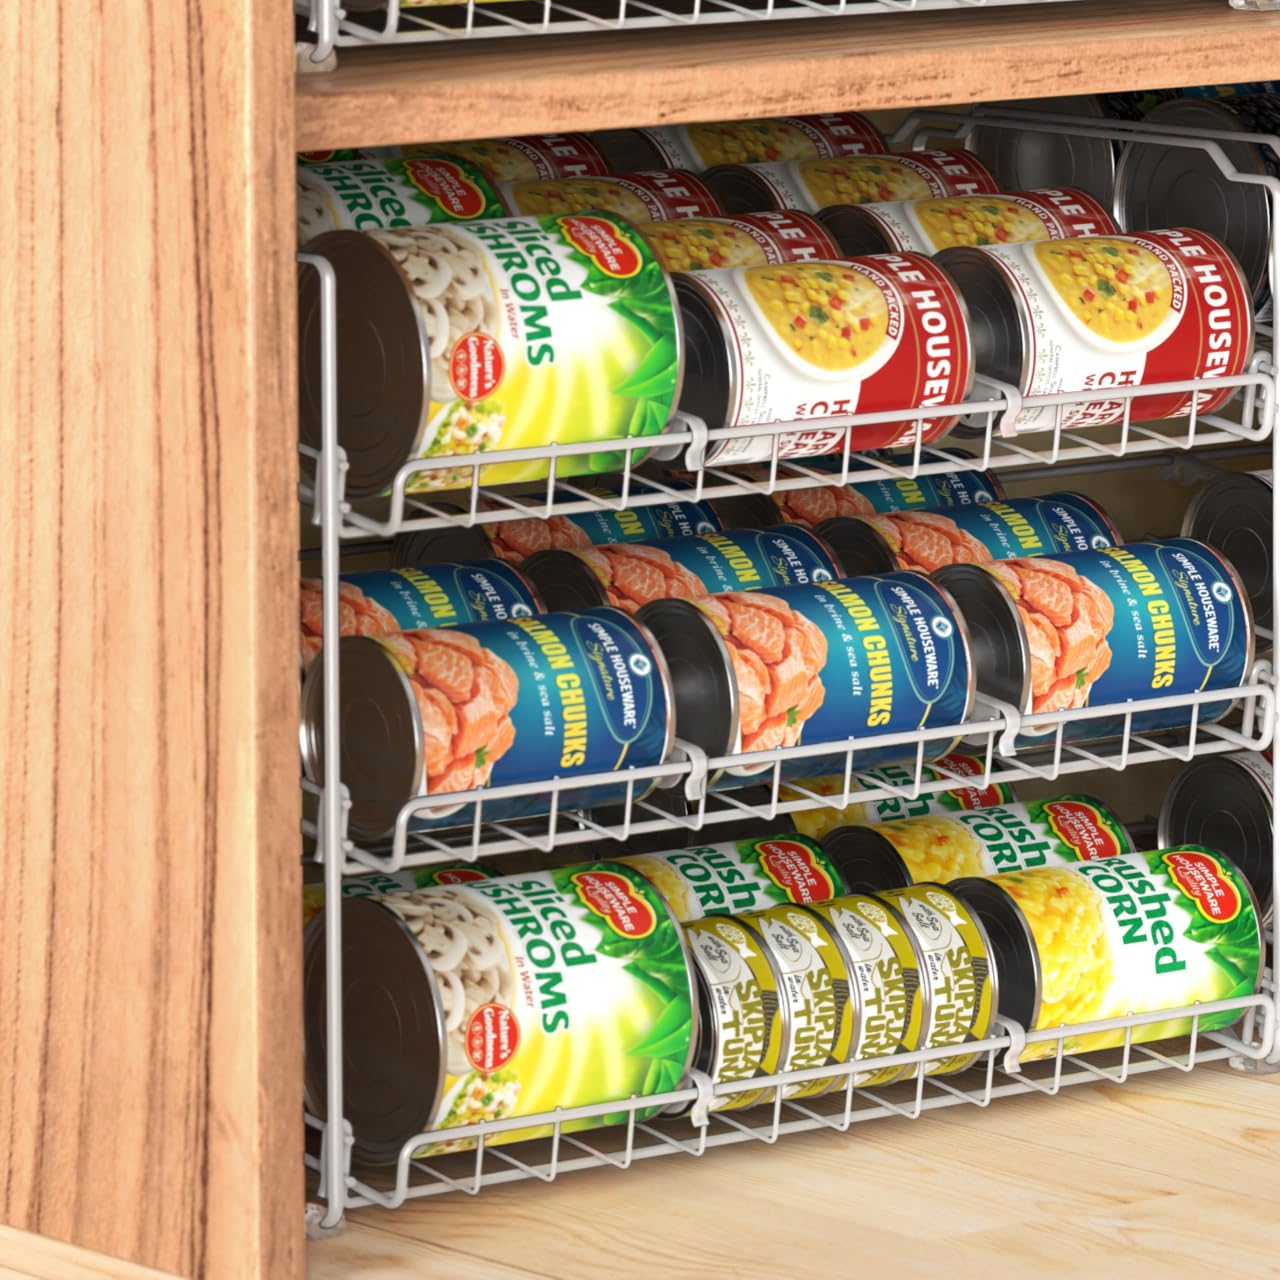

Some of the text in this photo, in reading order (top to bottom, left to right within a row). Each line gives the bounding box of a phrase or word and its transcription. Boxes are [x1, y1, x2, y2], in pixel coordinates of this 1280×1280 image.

[433, 166, 467, 198] SIMPLE
[591, 224, 624, 256] SIMPLE
[498, 219, 583, 303] Sliced
[1135, 239, 1184, 310] HAND PACKED
[852, 264, 904, 338] HAND PACKED
[503, 302, 520, 340] Water
[467, 336, 479, 399] Goodness
[482, 339, 494, 390] Nature's
[1052, 507, 1082, 536] SIMPLE
[772, 538, 803, 568] SIMPLE
[471, 572, 499, 603] SIMPLE
[1108, 568, 1131, 598] brine
[1172, 568, 1201, 627] Signature
[1172, 552, 1219, 650] SIMPLE HOUSEWARE
[823, 604, 845, 632] brine
[1127, 598, 1137, 608] &
[1131, 610, 1143, 633] sea
[890, 603, 919, 662] Signature
[891, 586, 938, 688] SIMPLE HOUSEWARE
[1137, 634, 1148, 659] salt
[1148, 600, 1174, 690] CHUNKS
[515, 644, 539, 672] brine
[585, 639, 616, 702] Signature
[589, 622, 635, 728] SIMPLE HOUSEWARE
[846, 645, 857, 668] sea
[538, 684, 551, 709] sea
[850, 669, 864, 696] salt
[862, 636, 894, 728] CHUNKS
[541, 711, 556, 737] salt
[555, 676, 589, 770] CHUNKS
[1071, 810, 1105, 846] SIMPLE
[787, 850, 818, 887] SIMPLE
[1172, 854, 1222, 915] HOUSEWARE
[1191, 859, 1225, 896] SIMPLE
[583, 874, 635, 932] HOUSEWARE
[606, 881, 638, 914] SIMPLE
[1079, 865, 1148, 946] CORN
[511, 879, 598, 968] Sliced
[856, 963, 870, 993] water
[926, 953, 939, 982] water
[519, 970, 536, 1008] Water
[715, 985, 727, 1015] water
[786, 974, 799, 1004] water
[483, 1007, 496, 1069] Goodness
[497, 1008, 510, 1060] Nature's
